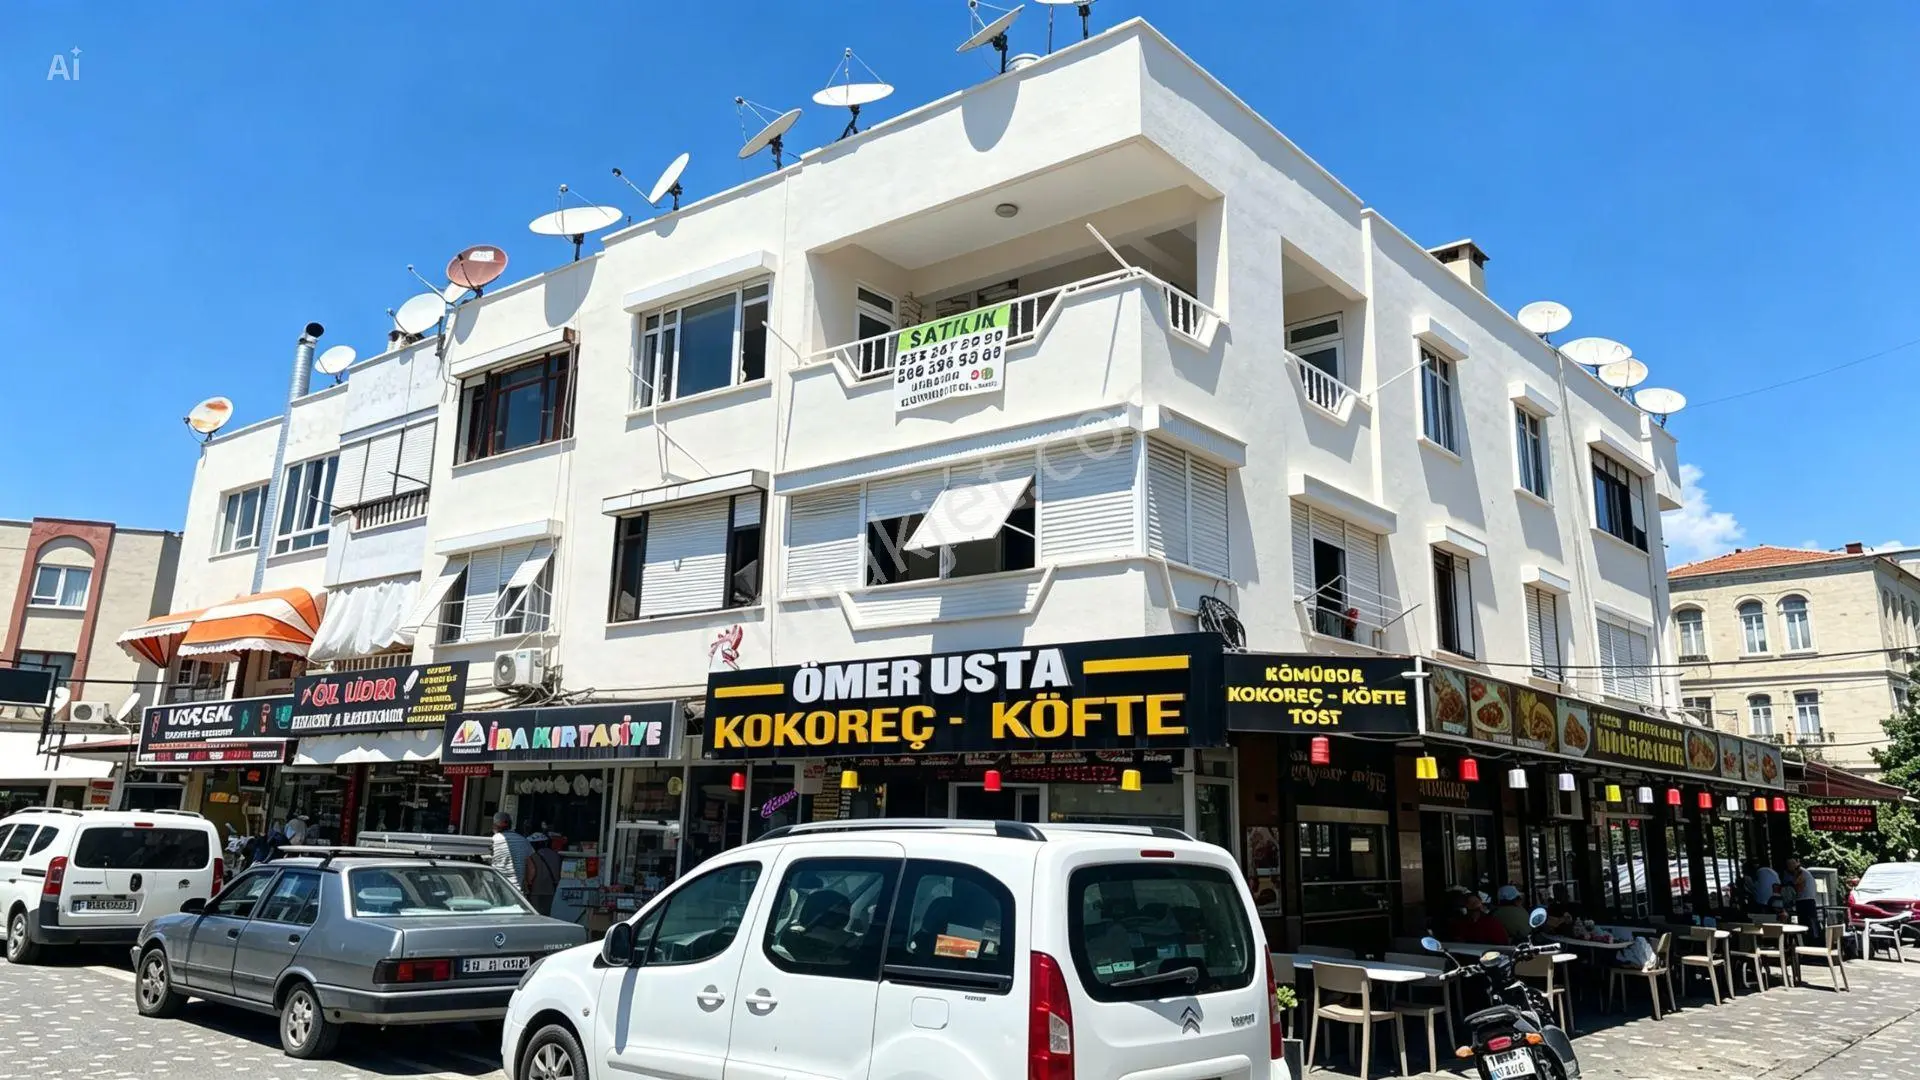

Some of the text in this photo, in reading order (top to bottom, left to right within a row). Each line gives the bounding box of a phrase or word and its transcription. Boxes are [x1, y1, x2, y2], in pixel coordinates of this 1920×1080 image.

[792, 648, 1073, 704] ÖMER USTA
[1228, 687, 1324, 708] KOKOREÇ
[487, 715, 663, 751] İDA KIRTASİYE
[714, 705, 937, 750] KOKOREÇ
[992, 692, 1189, 739] KÖFTE
[1288, 709, 1343, 725] TOST
